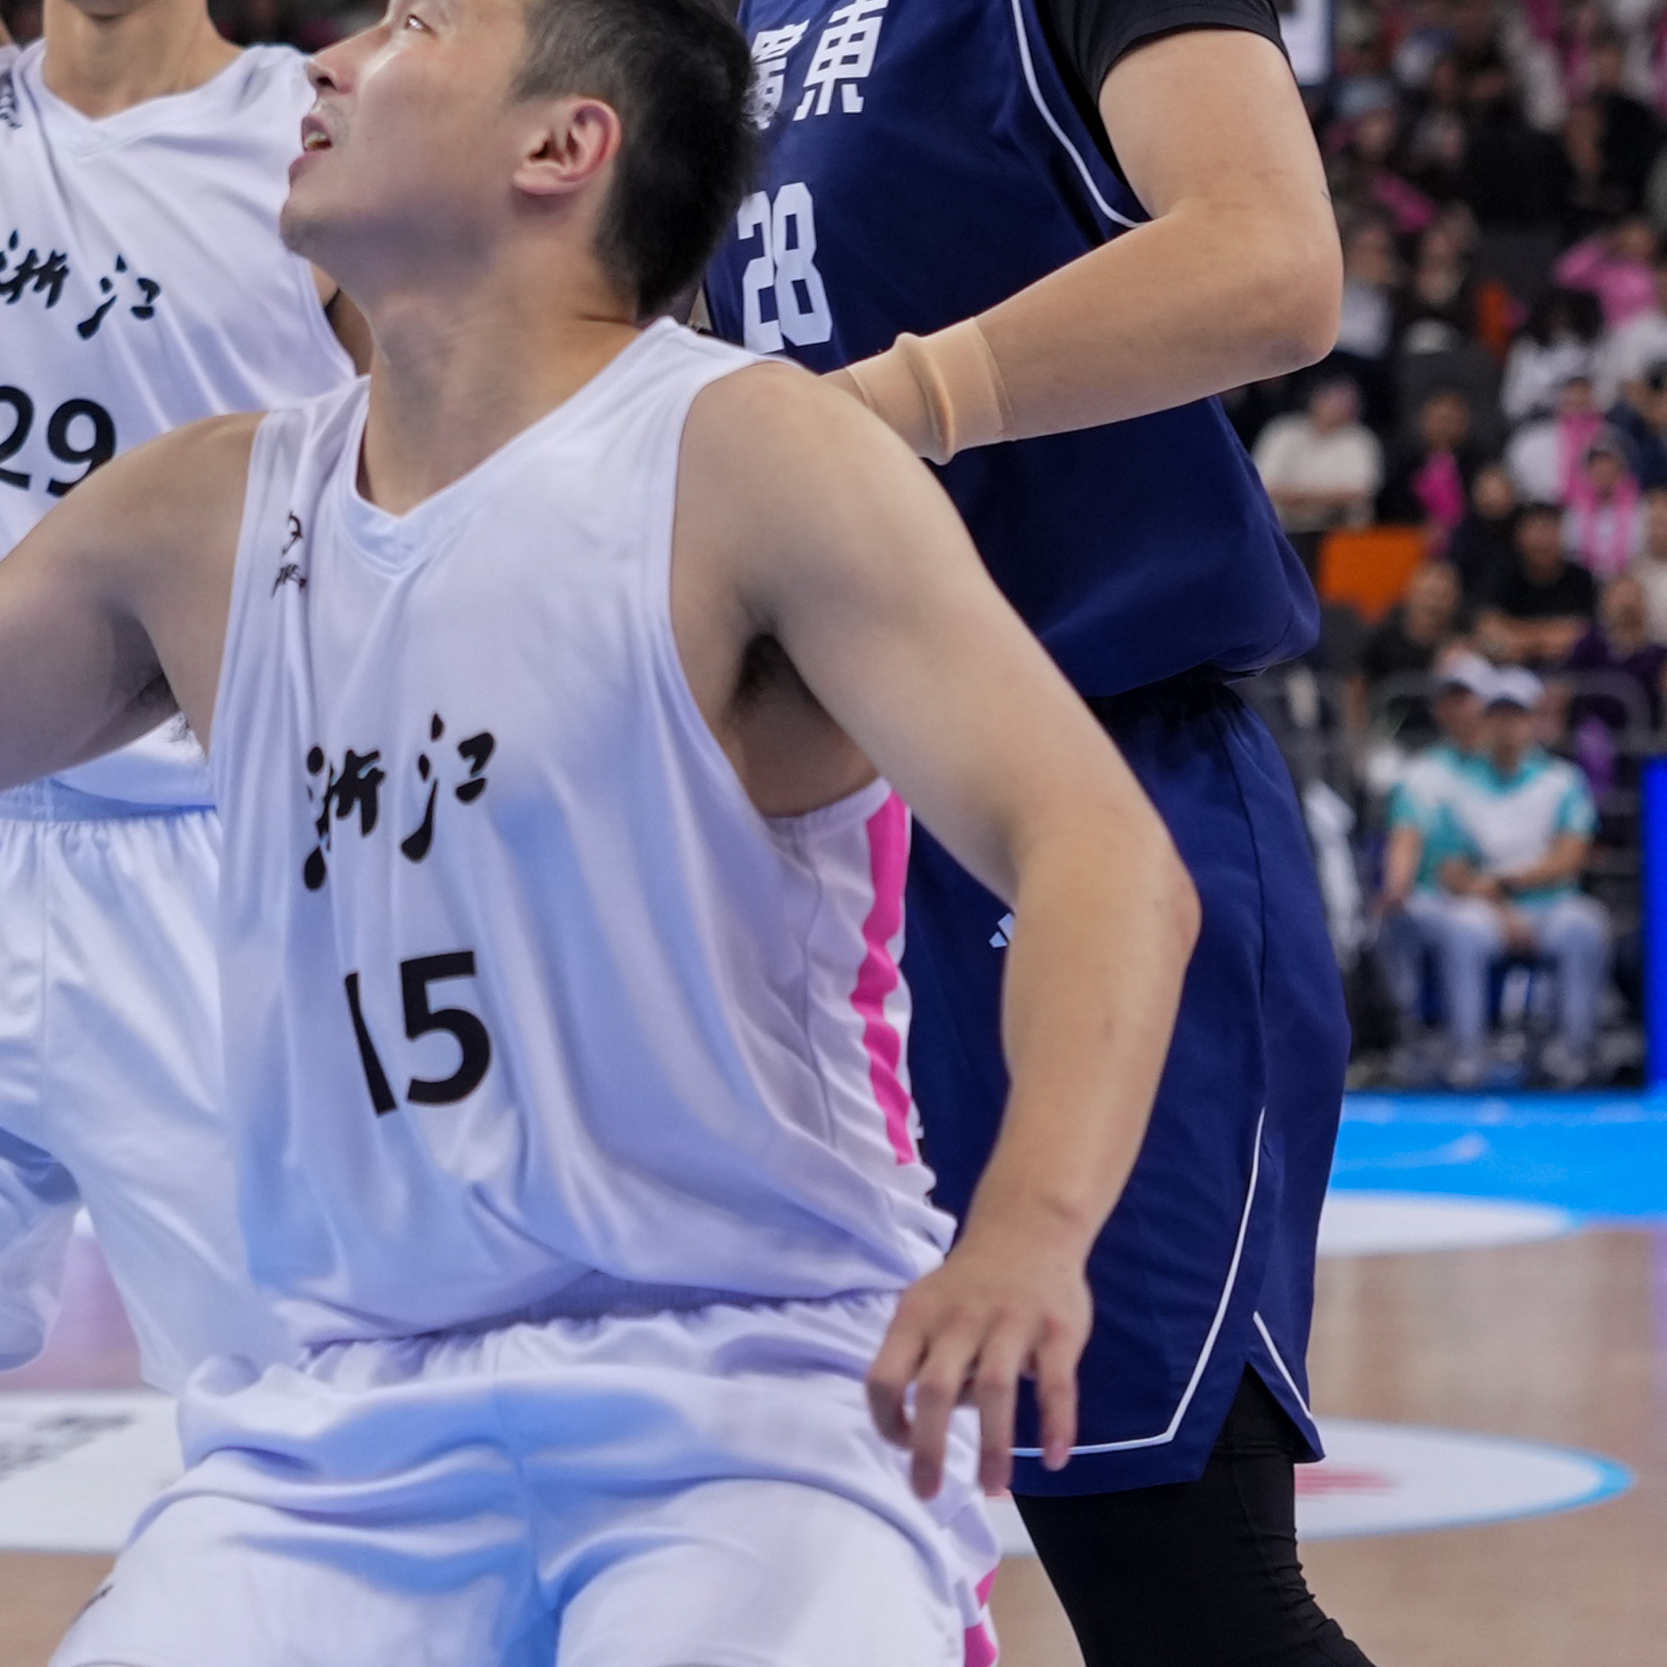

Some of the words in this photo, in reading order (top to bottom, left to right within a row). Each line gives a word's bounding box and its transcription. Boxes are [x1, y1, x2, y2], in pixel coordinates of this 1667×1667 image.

[736, 181, 833, 355] 28
[303, 713, 496, 891] 浙江
[344, 950, 491, 1117] 15
